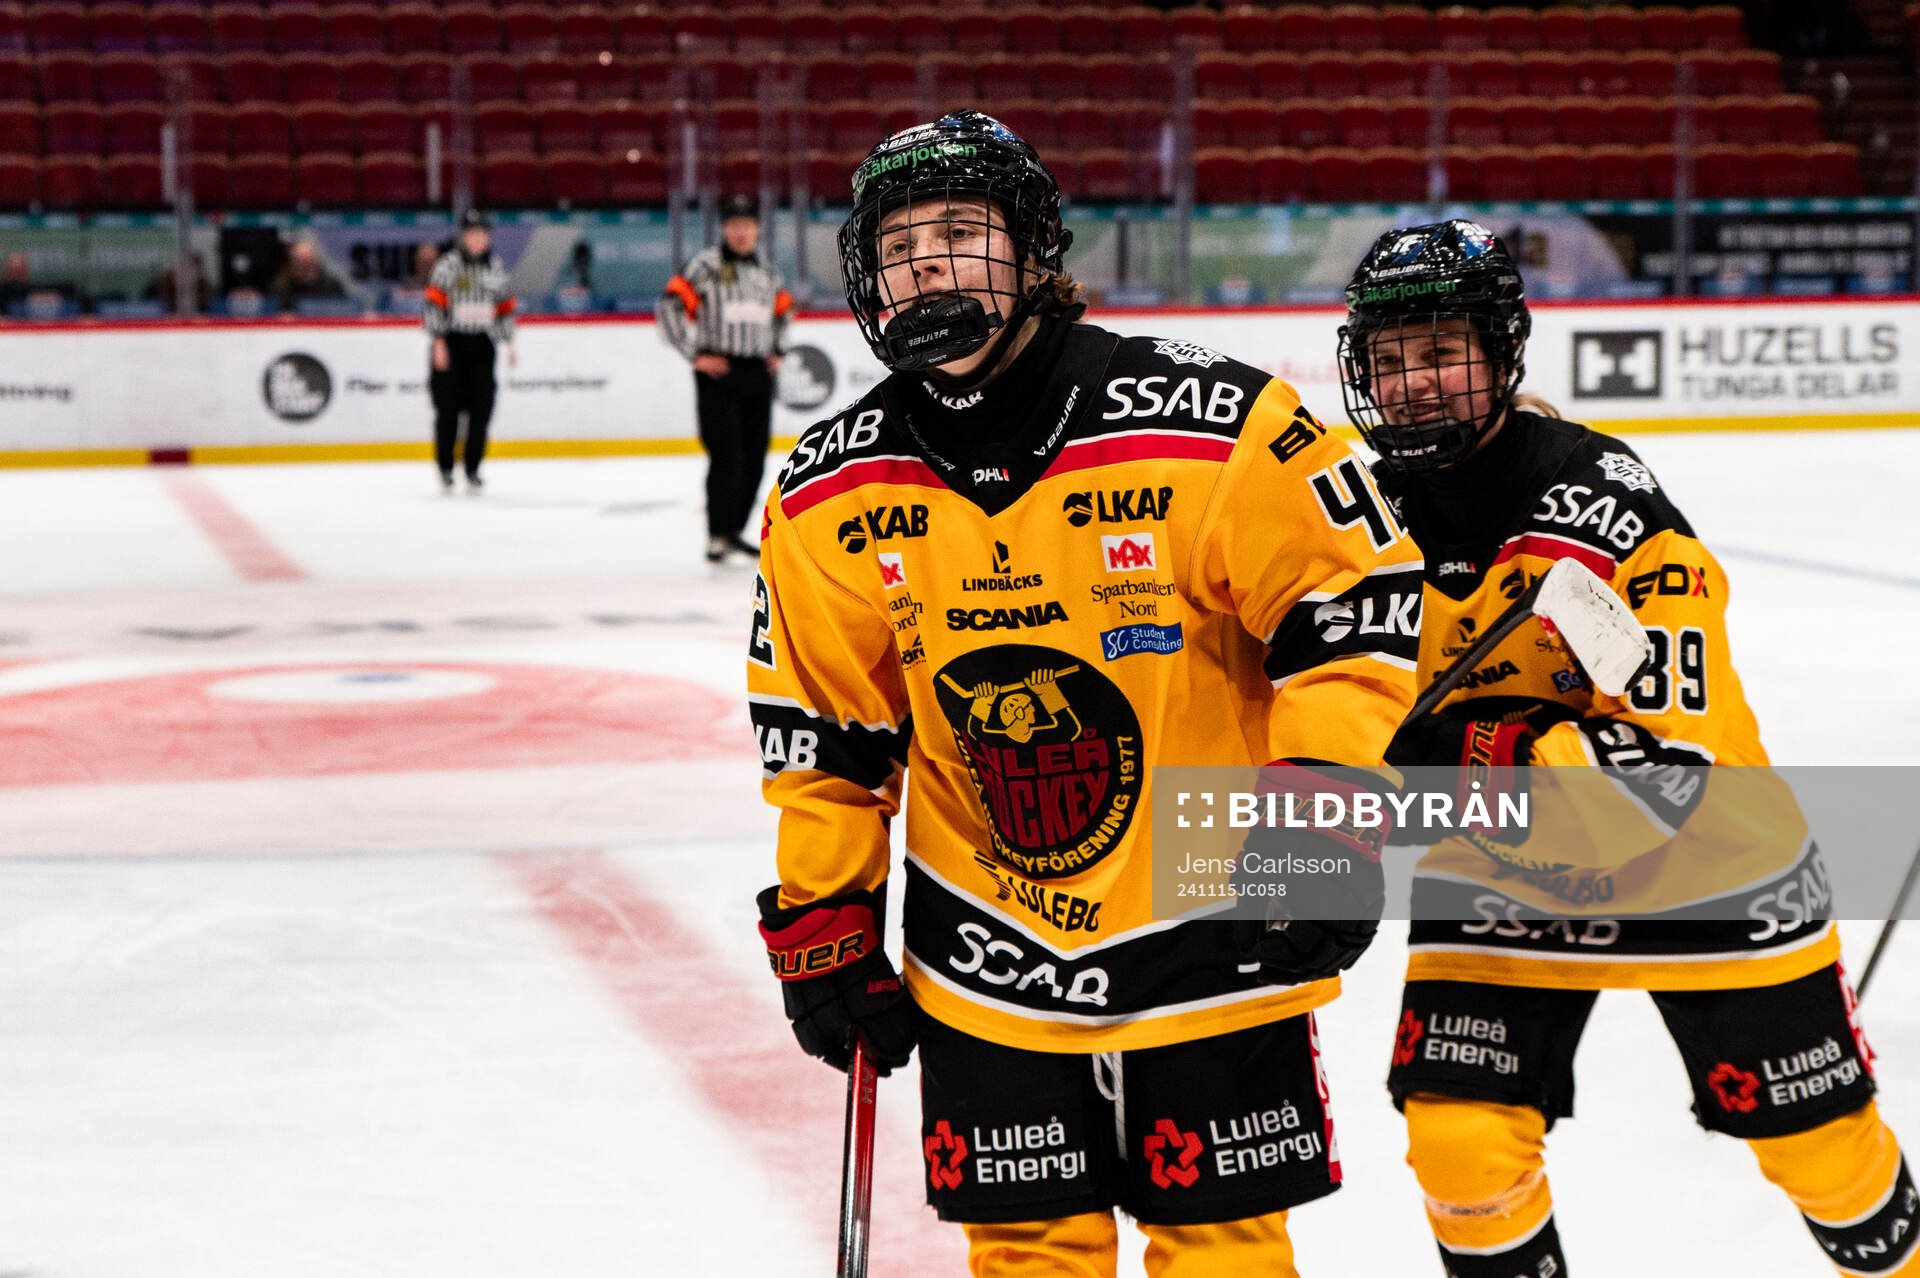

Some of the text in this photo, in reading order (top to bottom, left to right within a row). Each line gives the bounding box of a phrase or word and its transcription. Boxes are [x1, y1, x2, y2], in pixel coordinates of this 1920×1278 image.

[1681, 324, 1897, 366] HUZELLS
[1102, 376, 1244, 425] SSAB
[1682, 371, 1897, 400] TUNGA DELAR
[1047, 385, 1081, 450] BAUER
[865, 505, 928, 543] KAB
[1533, 484, 1645, 550] SSAB
[1107, 538, 1153, 569] MAX
[962, 574, 1043, 592] LINDBÄCKS
[1091, 579, 1176, 604] Sparbanken
[946, 601, 1069, 632] SCANIA
[1120, 600, 1158, 619] Nord
[1131, 627, 1166, 642] Student
[1132, 637, 1183, 652] Consulting
[1116, 735, 1136, 786] 1977
[950, 923, 1109, 1007] SSAB
[1429, 1013, 1506, 1044] Luleå
[1425, 1039, 1519, 1074] Energi
[1762, 1036, 1842, 1082] Luleå
[1770, 1058, 1861, 1107] Energi
[973, 1116, 1066, 1152] Luleå
[1209, 1099, 1300, 1146] Luleå
[976, 1150, 1086, 1184] Energi
[1215, 1130, 1322, 1177] Energi
